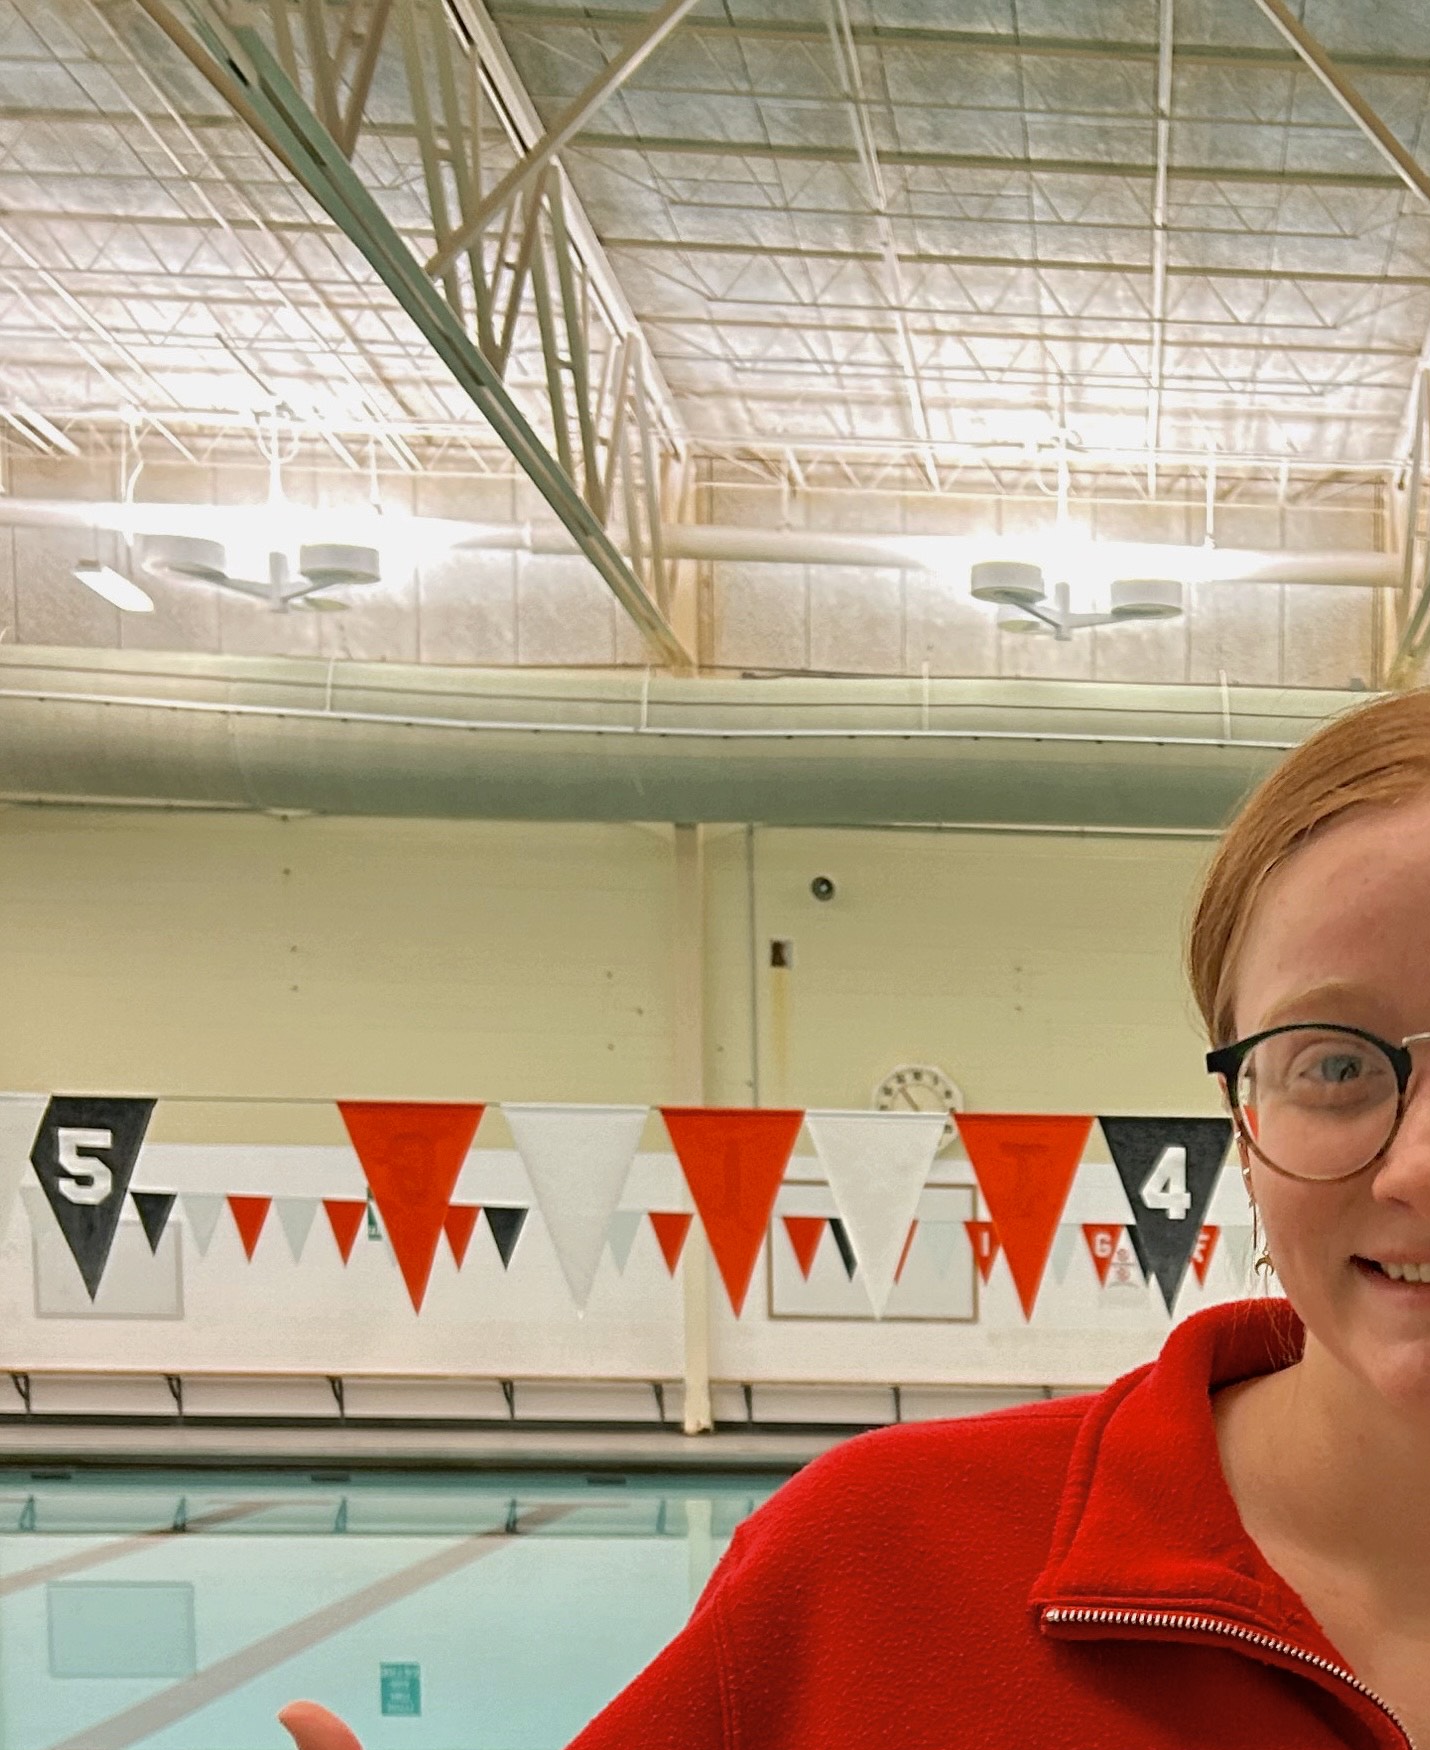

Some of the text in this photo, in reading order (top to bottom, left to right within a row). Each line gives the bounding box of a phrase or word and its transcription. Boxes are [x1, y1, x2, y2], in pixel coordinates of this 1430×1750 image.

[57, 1127, 113, 1205] 5
[1138, 1146, 1192, 1221] 4
[1093, 1233, 1113, 1259] G
